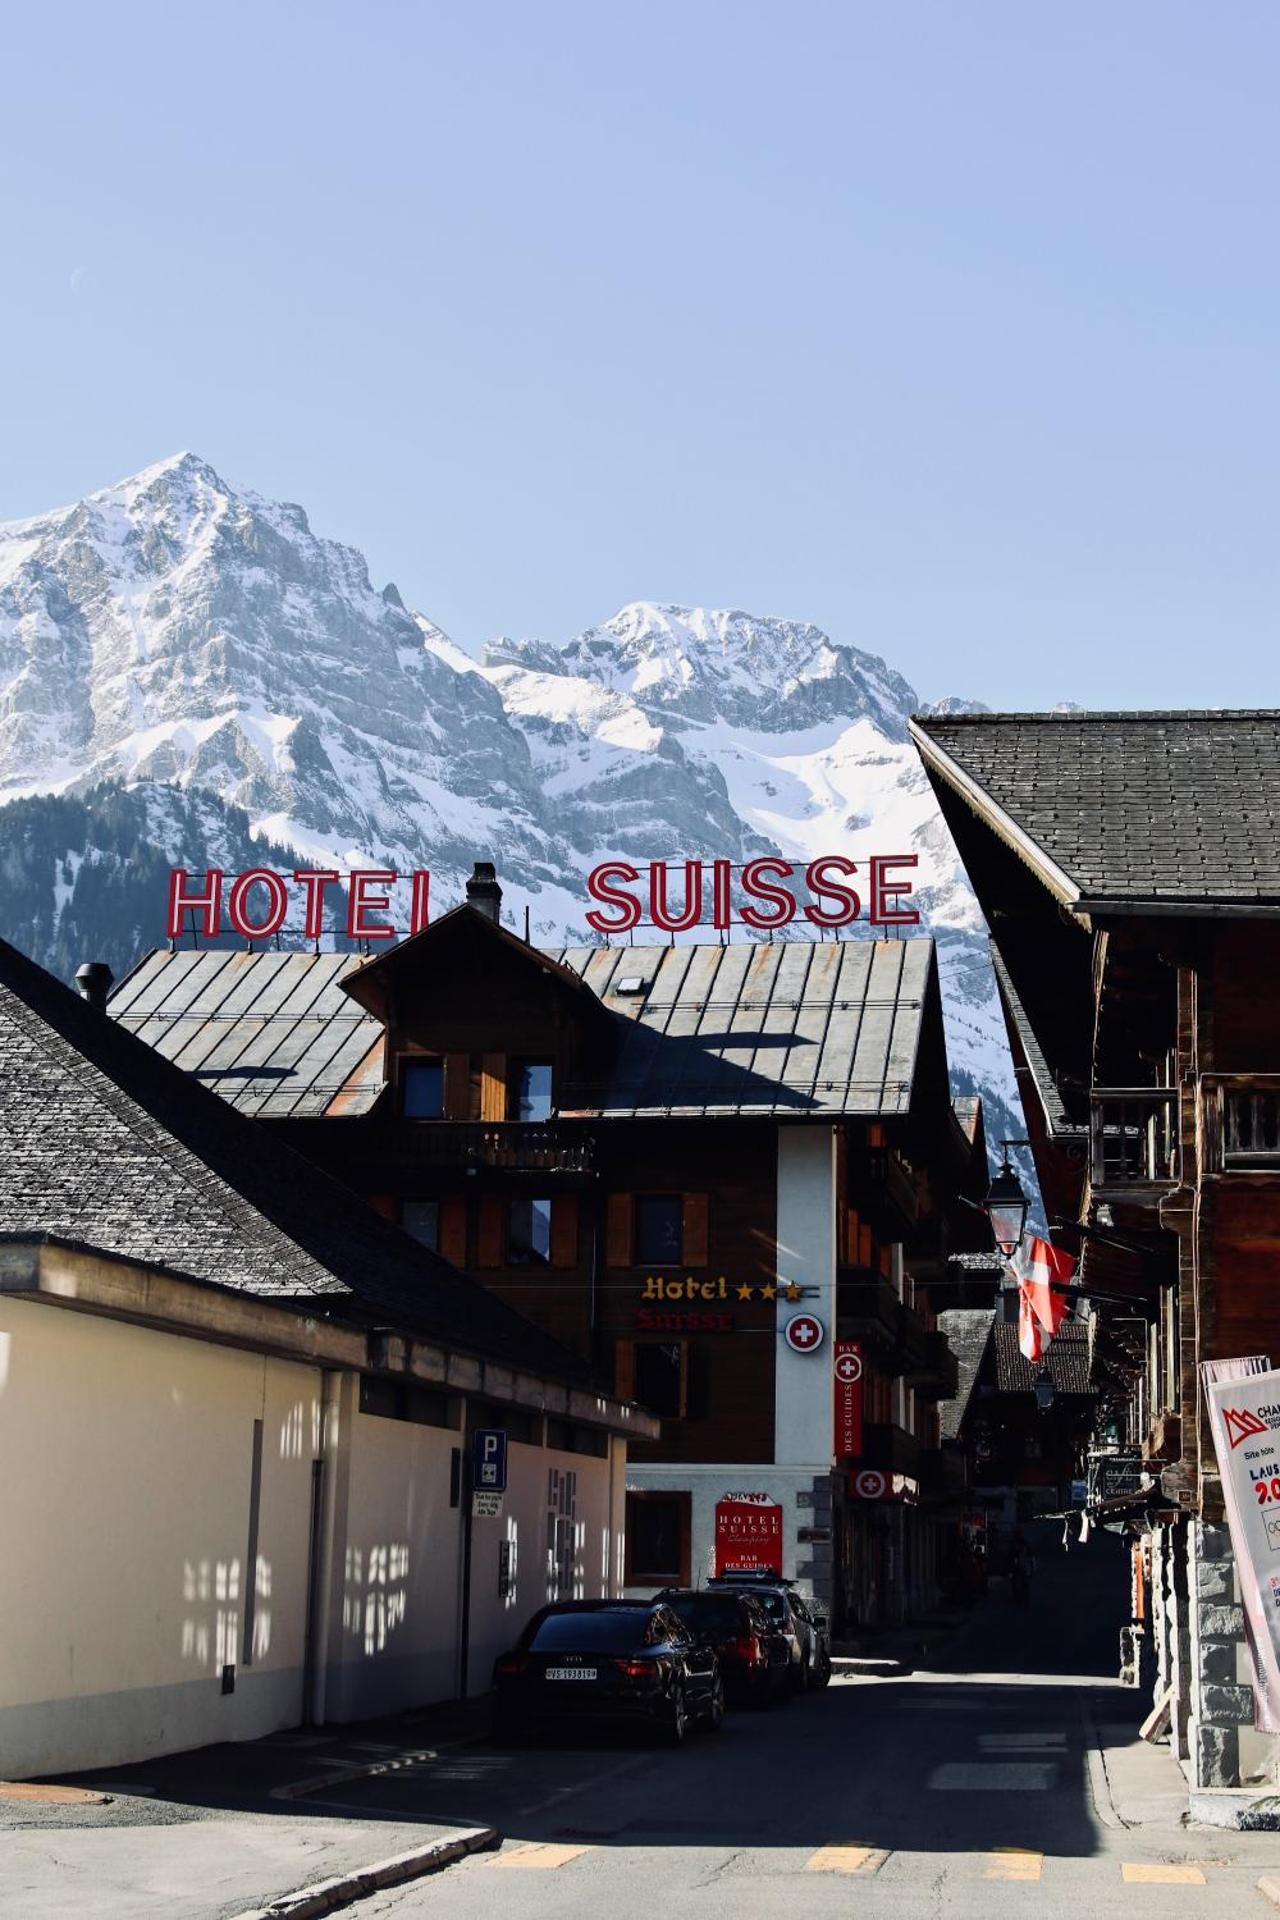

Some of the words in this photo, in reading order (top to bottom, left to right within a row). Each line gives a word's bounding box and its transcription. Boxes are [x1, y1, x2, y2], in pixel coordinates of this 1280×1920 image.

[586, 855, 919, 932] SUISSE
[640, 1276, 728, 1301] Hotel
[839, 1345, 858, 1353] BAR
[844, 1384, 854, 1426] GUIDES
[1257, 1404, 1280, 1418] CHA
[484, 1435, 498, 1461] P
[844, 1431, 854, 1453] DES
[1244, 1451, 1260, 1460] Site
[719, 1515, 779, 1524] HOTEL
[719, 1525, 779, 1534] SUISSE
